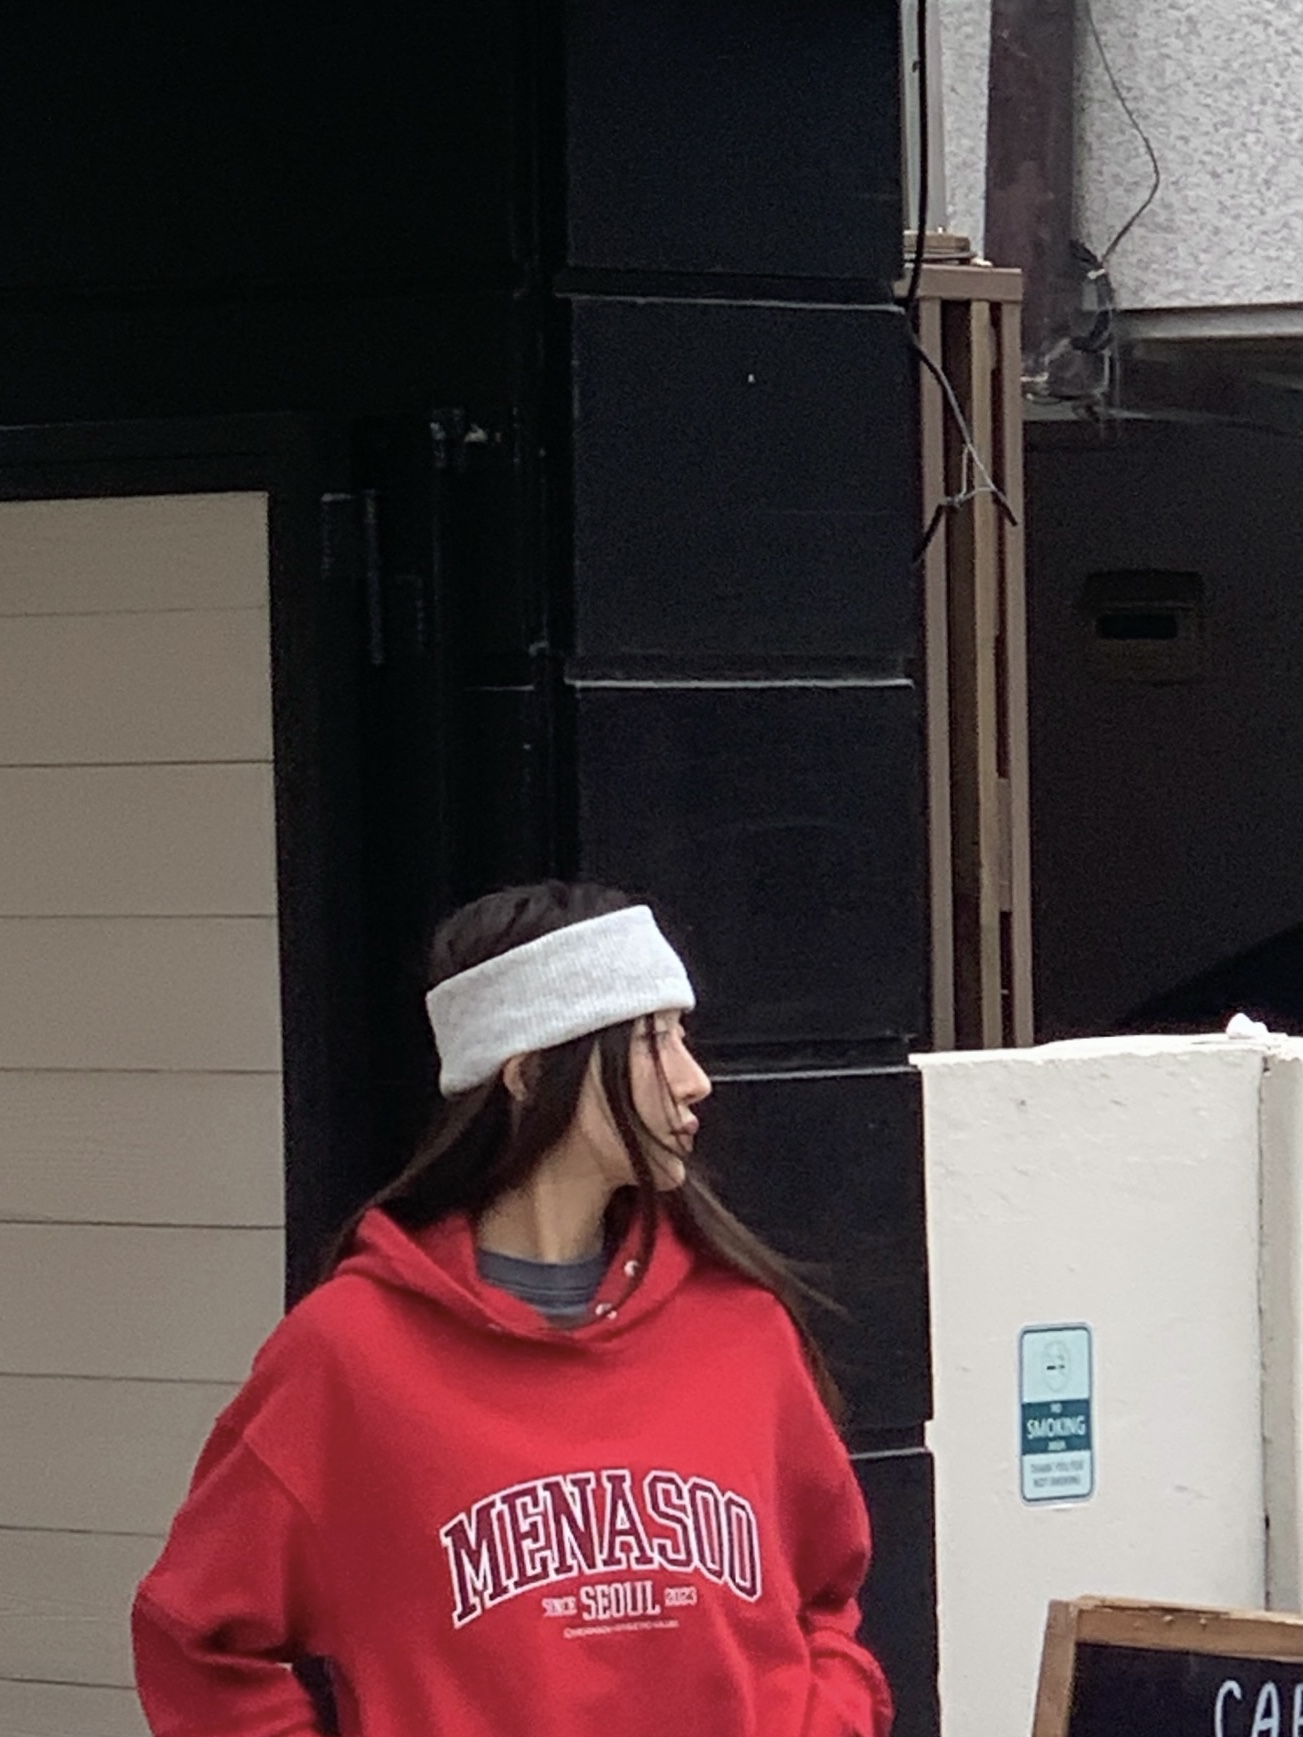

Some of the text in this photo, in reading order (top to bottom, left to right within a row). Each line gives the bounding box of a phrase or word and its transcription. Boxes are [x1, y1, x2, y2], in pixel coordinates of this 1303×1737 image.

[1026, 1415, 1086, 1440] SMOKING
[439, 1469, 763, 1630] MENASOO
[579, 1579, 662, 1621] SEOUL
